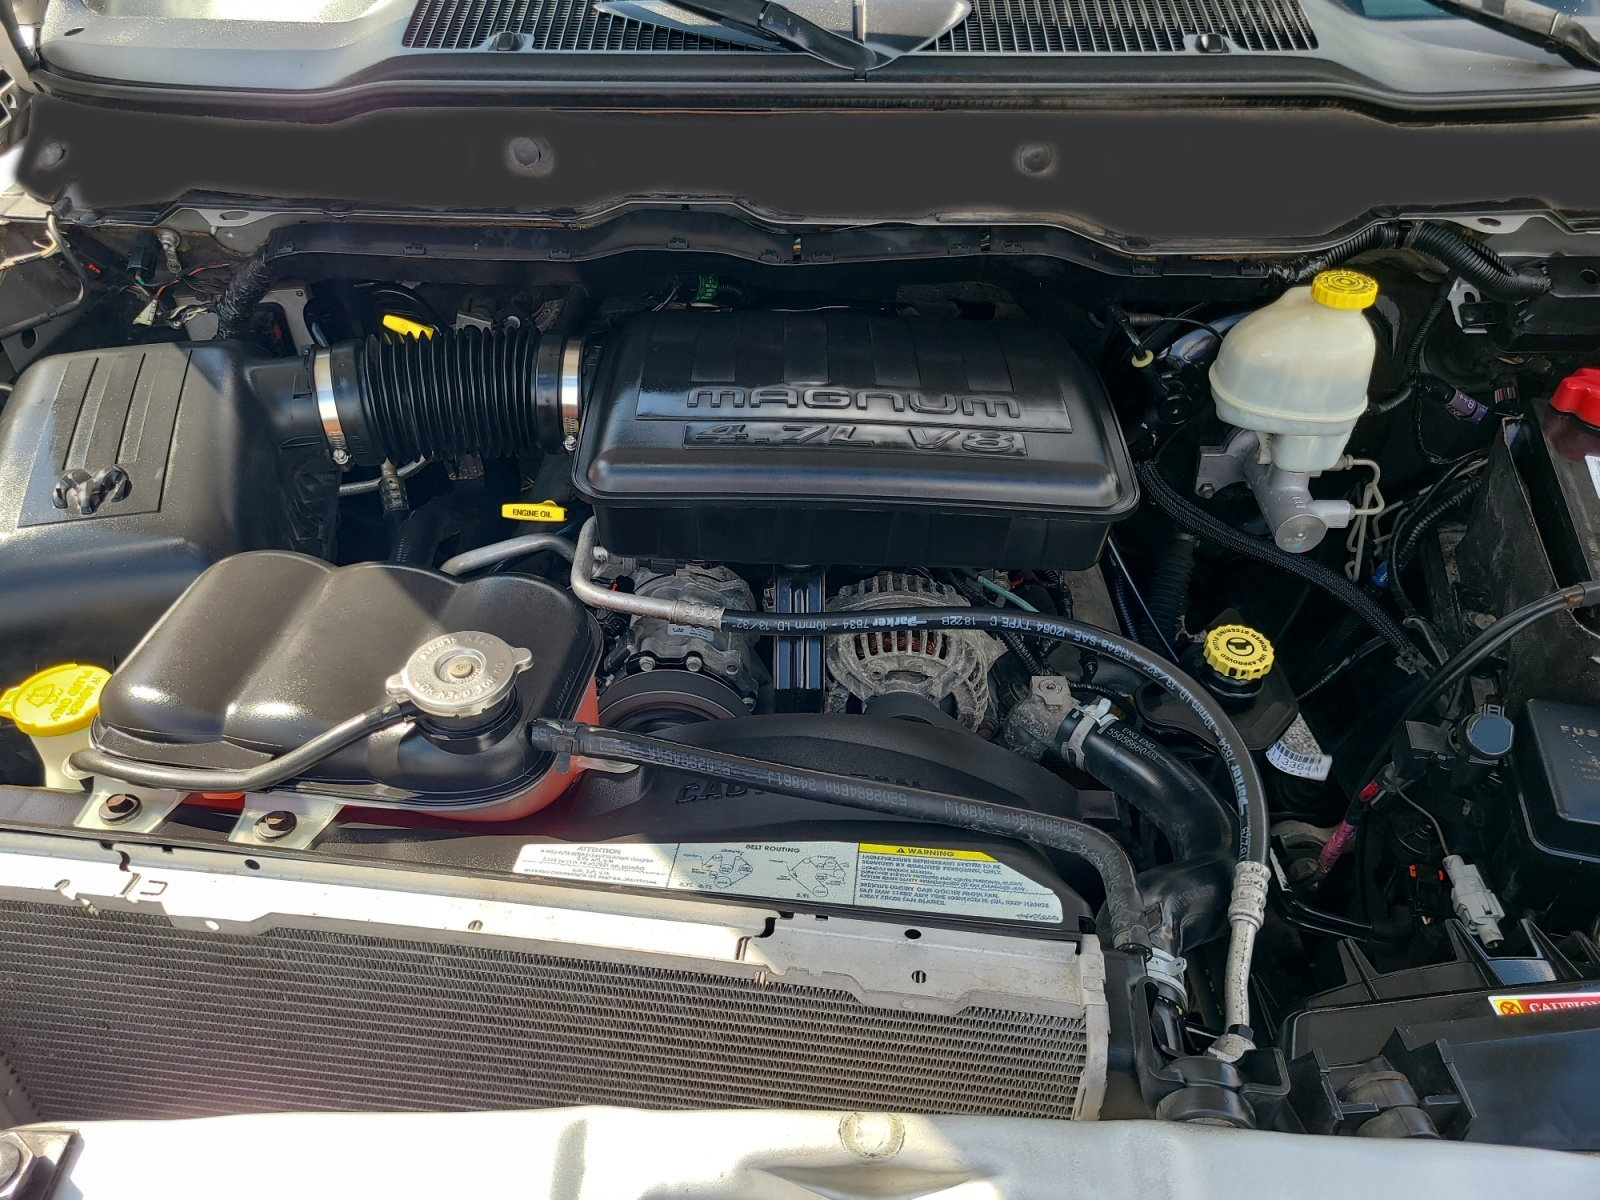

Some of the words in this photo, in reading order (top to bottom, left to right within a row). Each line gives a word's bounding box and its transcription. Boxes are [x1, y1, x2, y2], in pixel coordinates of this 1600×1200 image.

[687, 387, 1021, 418] MAGNUM
[695, 424, 876, 447] 4.7L
[908, 428, 1015, 452] V8
[512, 508, 539, 518] ENGINE
[793, 620, 828, 631] 10mm
[872, 616, 926, 628] Parker
[1001, 616, 1032, 631] TYPE
[1075, 632, 1096, 644] SAE
[1215, 628, 1250, 638] STEERING
[1212, 636, 1220, 651] FLUID
[1250, 633, 1269, 652] POWER
[1220, 653, 1257, 666] APPROVED
[1256, 653, 1269, 664] USE
[1122, 727, 1140, 740] ENG
[1138, 737, 1156, 749] END
[745, 844, 762, 852] BELT
[765, 845, 801, 853] ROUTING
[907, 848, 955, 857] WARNING
